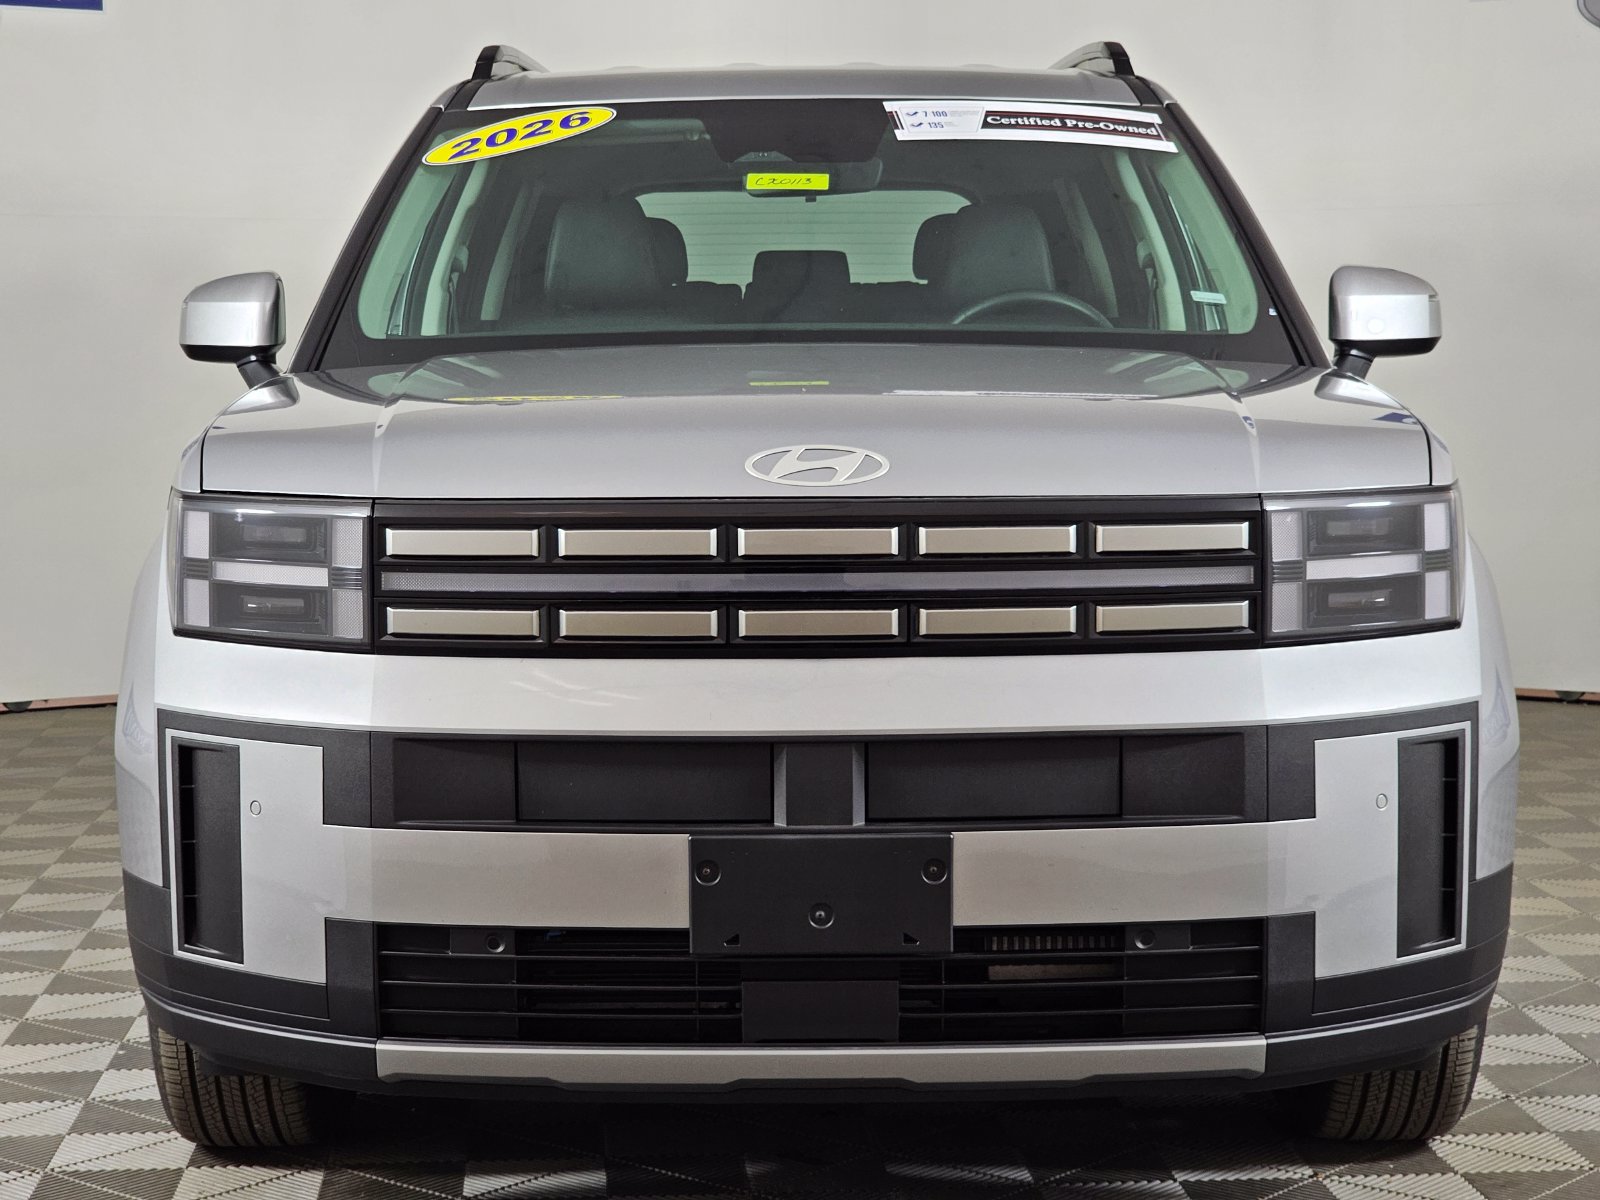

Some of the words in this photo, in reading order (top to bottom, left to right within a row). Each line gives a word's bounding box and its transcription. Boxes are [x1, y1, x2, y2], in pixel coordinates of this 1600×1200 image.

[447, 111, 592, 162] 2026
[986, 115, 1062, 128] Certified
[1064, 118, 1158, 136] Pre-Owned
